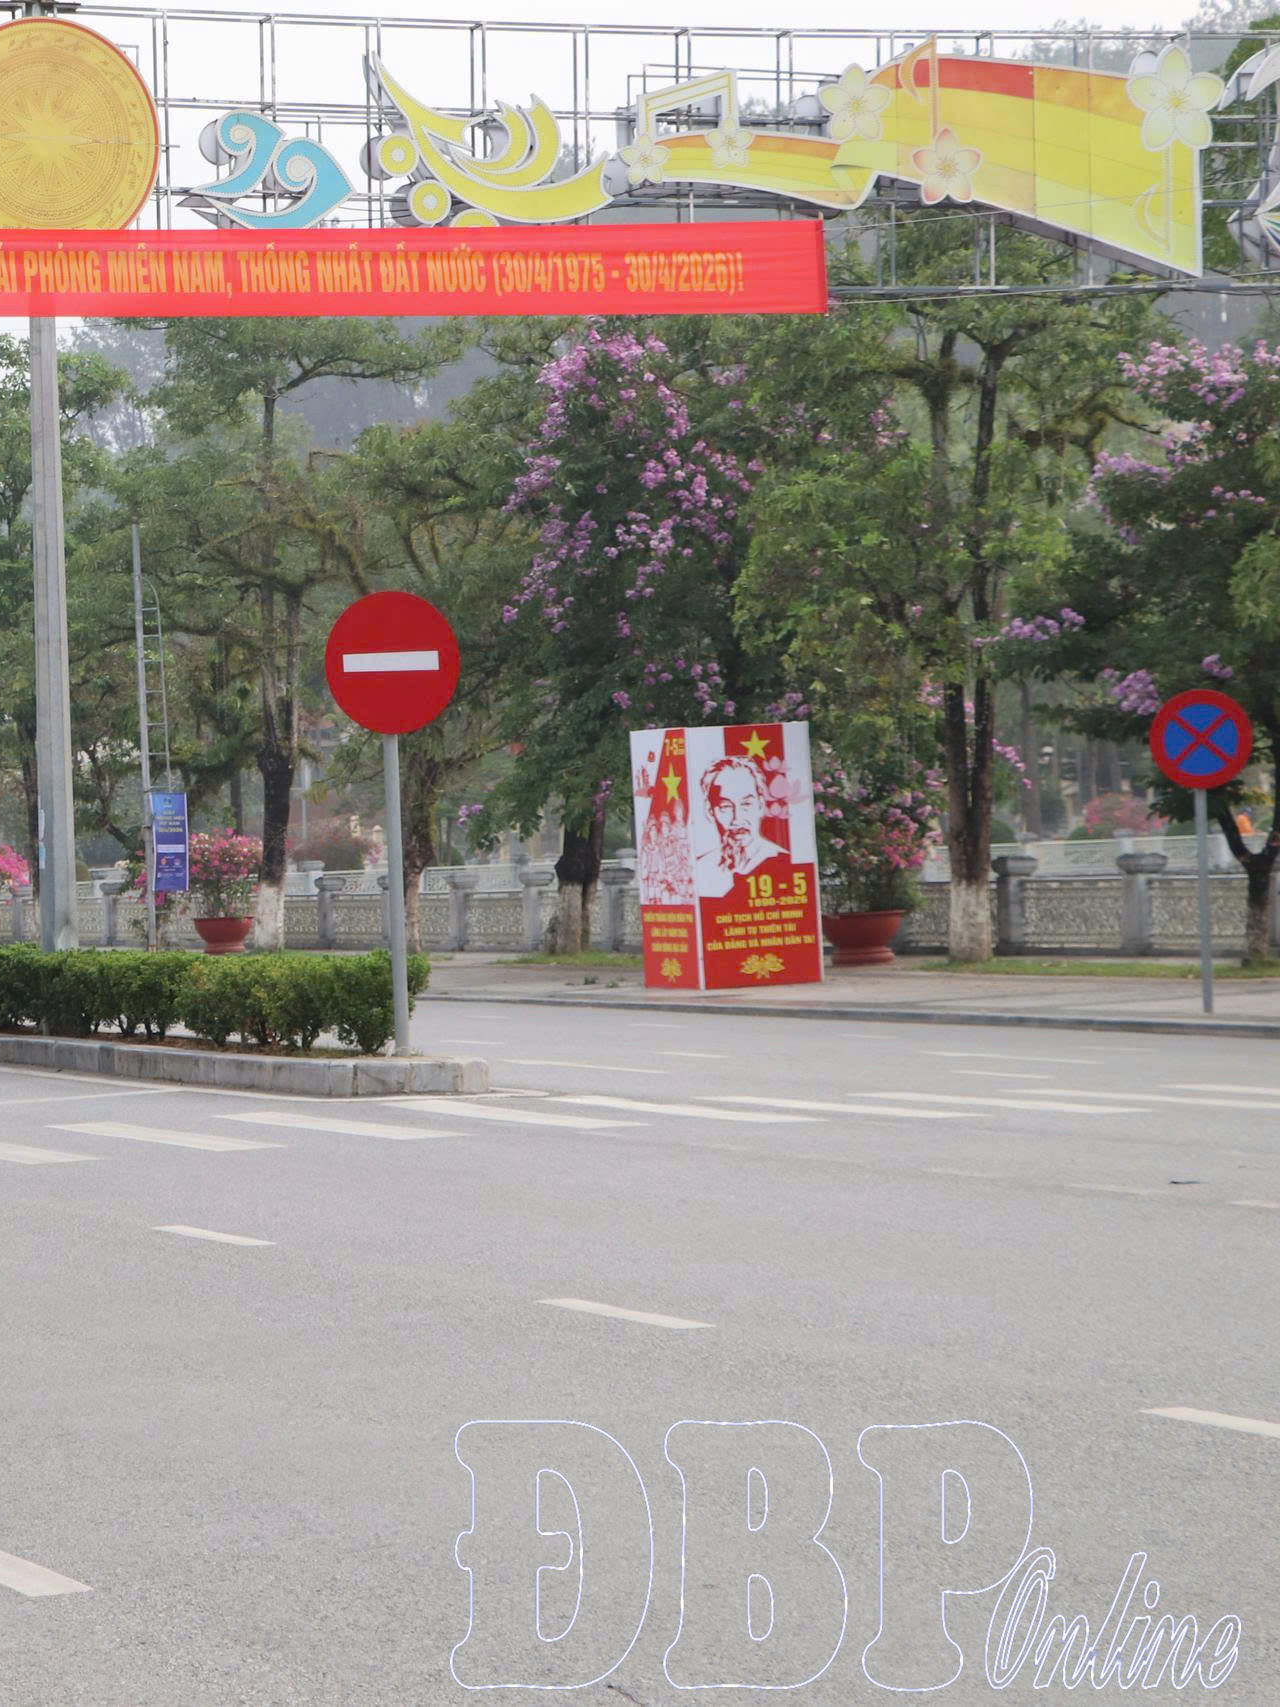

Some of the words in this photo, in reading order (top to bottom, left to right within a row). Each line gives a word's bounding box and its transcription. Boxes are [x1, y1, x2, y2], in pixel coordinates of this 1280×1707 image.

[23, 240, 101, 294] PHÓNG
[107, 242, 167, 294] MIỀN
[172, 250, 233, 299] NAM,
[237, 242, 312, 294] THỐNG
[316, 242, 373, 294] NHẤT
[379, 242, 420, 294] ĐẤT
[427, 242, 487, 294] NƯỚC
[492, 251, 606, 298] (30/4/1975
[624, 250, 744, 298] 30/4/2026)!
[746, 874, 773, 898] 19
[793, 872, 807, 896] 5
